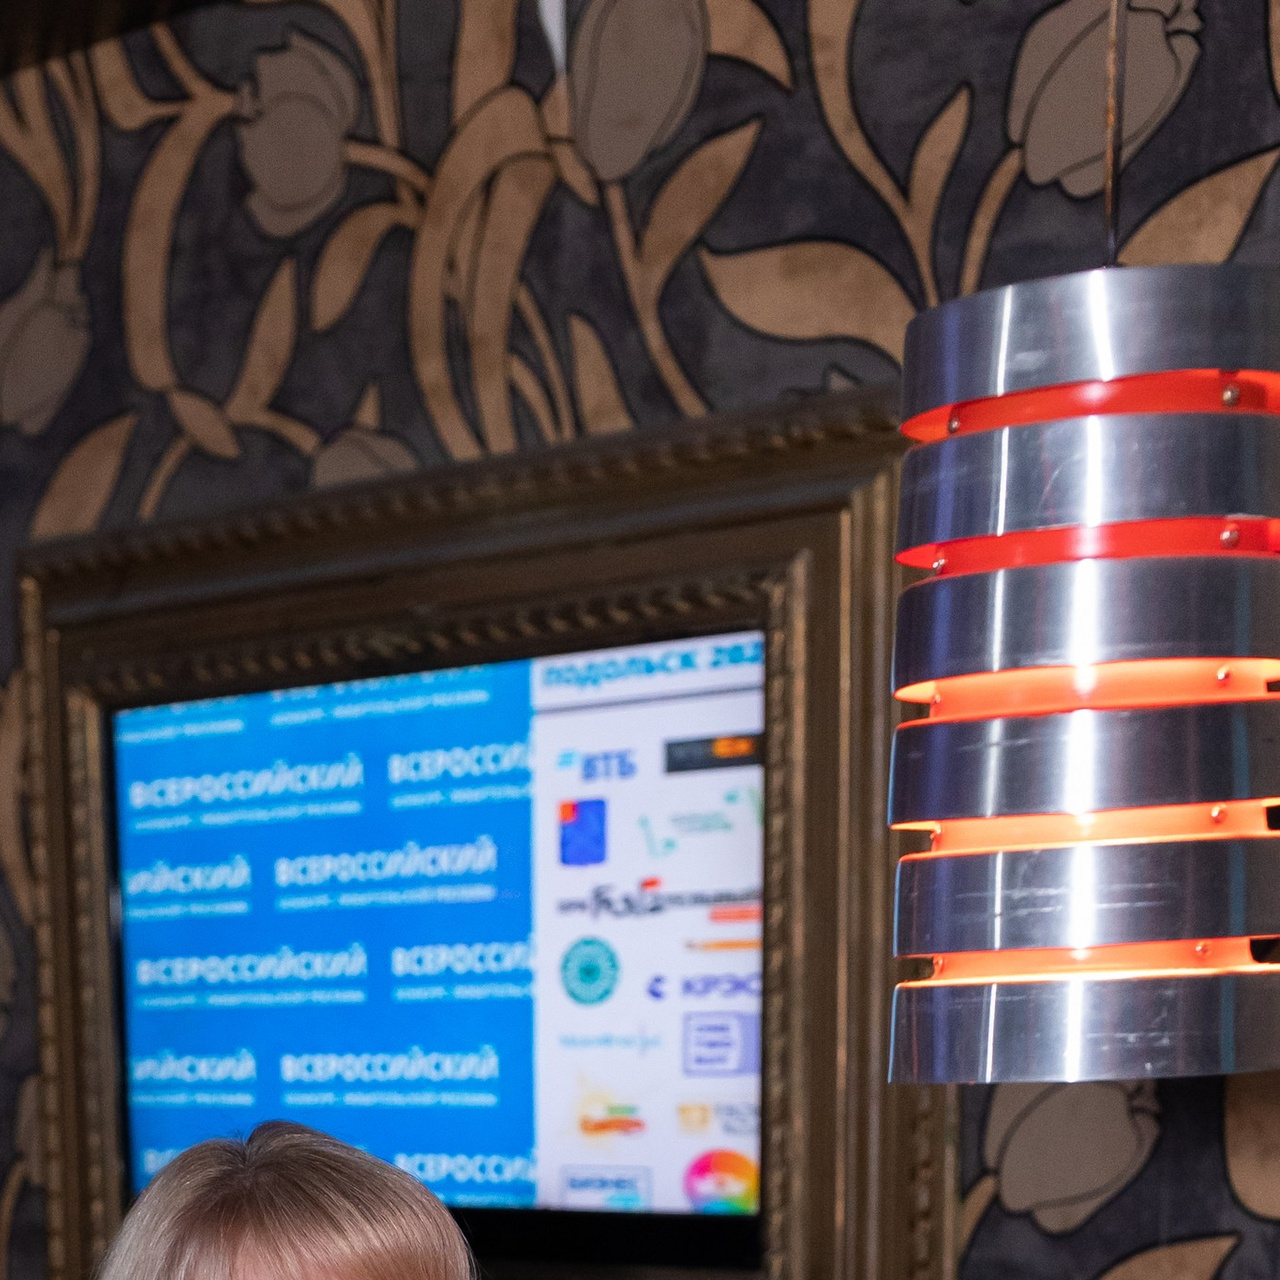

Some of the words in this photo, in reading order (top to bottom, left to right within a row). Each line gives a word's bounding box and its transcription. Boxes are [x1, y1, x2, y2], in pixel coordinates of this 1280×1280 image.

[130, 752, 364, 808] ВСЕРОССИЙСКИЙ
[388, 742, 532, 782] ВСЕРОССИ
[582, 751, 636, 781] ВТБ
[275, 834, 497, 887] ВСЕРОССИЙСКИЙ
[136, 942, 367, 986] ВСЕРОССИЙСКИЙ
[391, 940, 532, 976] ВСЕРОССИ
[280, 1044, 500, 1082] ВСЕРОССИЙСКИЙ
